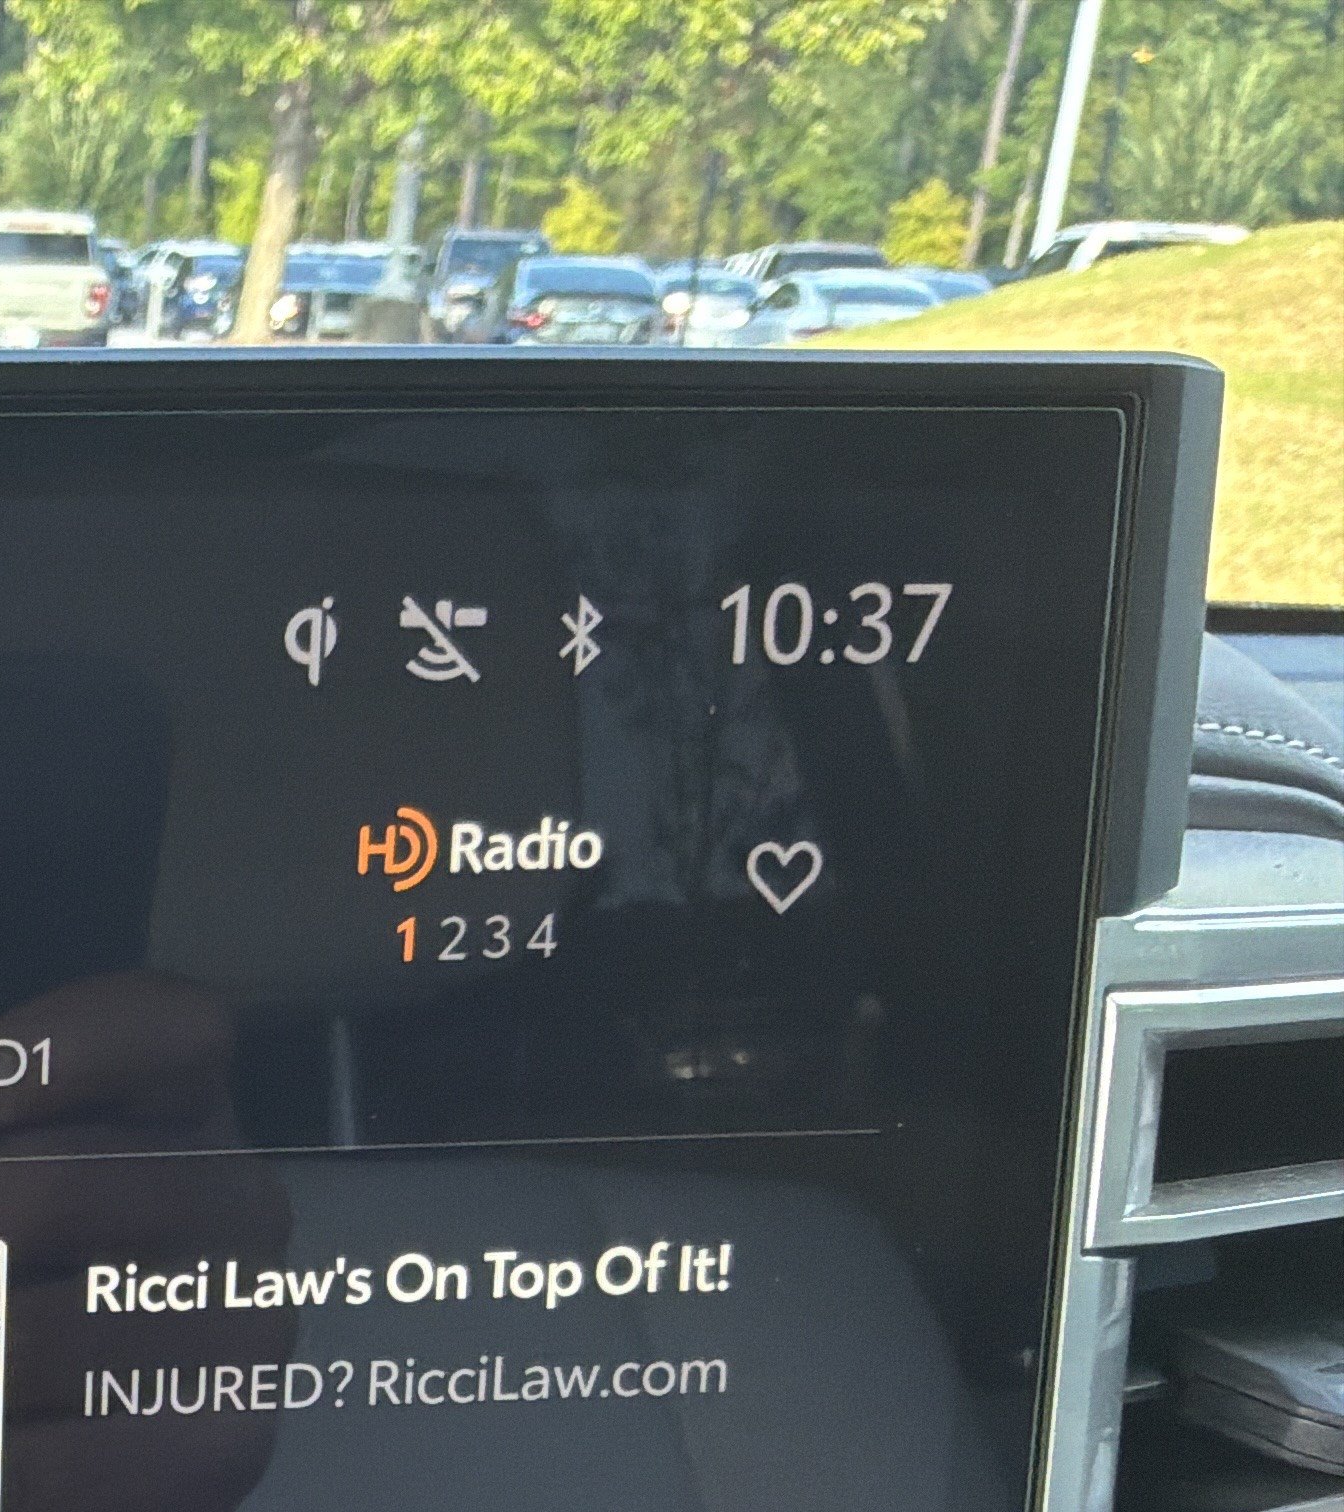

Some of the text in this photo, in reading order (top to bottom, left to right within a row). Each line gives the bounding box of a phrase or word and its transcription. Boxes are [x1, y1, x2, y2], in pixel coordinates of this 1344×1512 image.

[721, 582, 953, 665] 10:37
[449, 816, 603, 874] Radio
[396, 913, 557, 962] 1 2 3 4
[86, 1240, 732, 1313] Ricci Law's On Top Of It!
[84, 1355, 728, 1417] INJURED? RicciLaw.com
